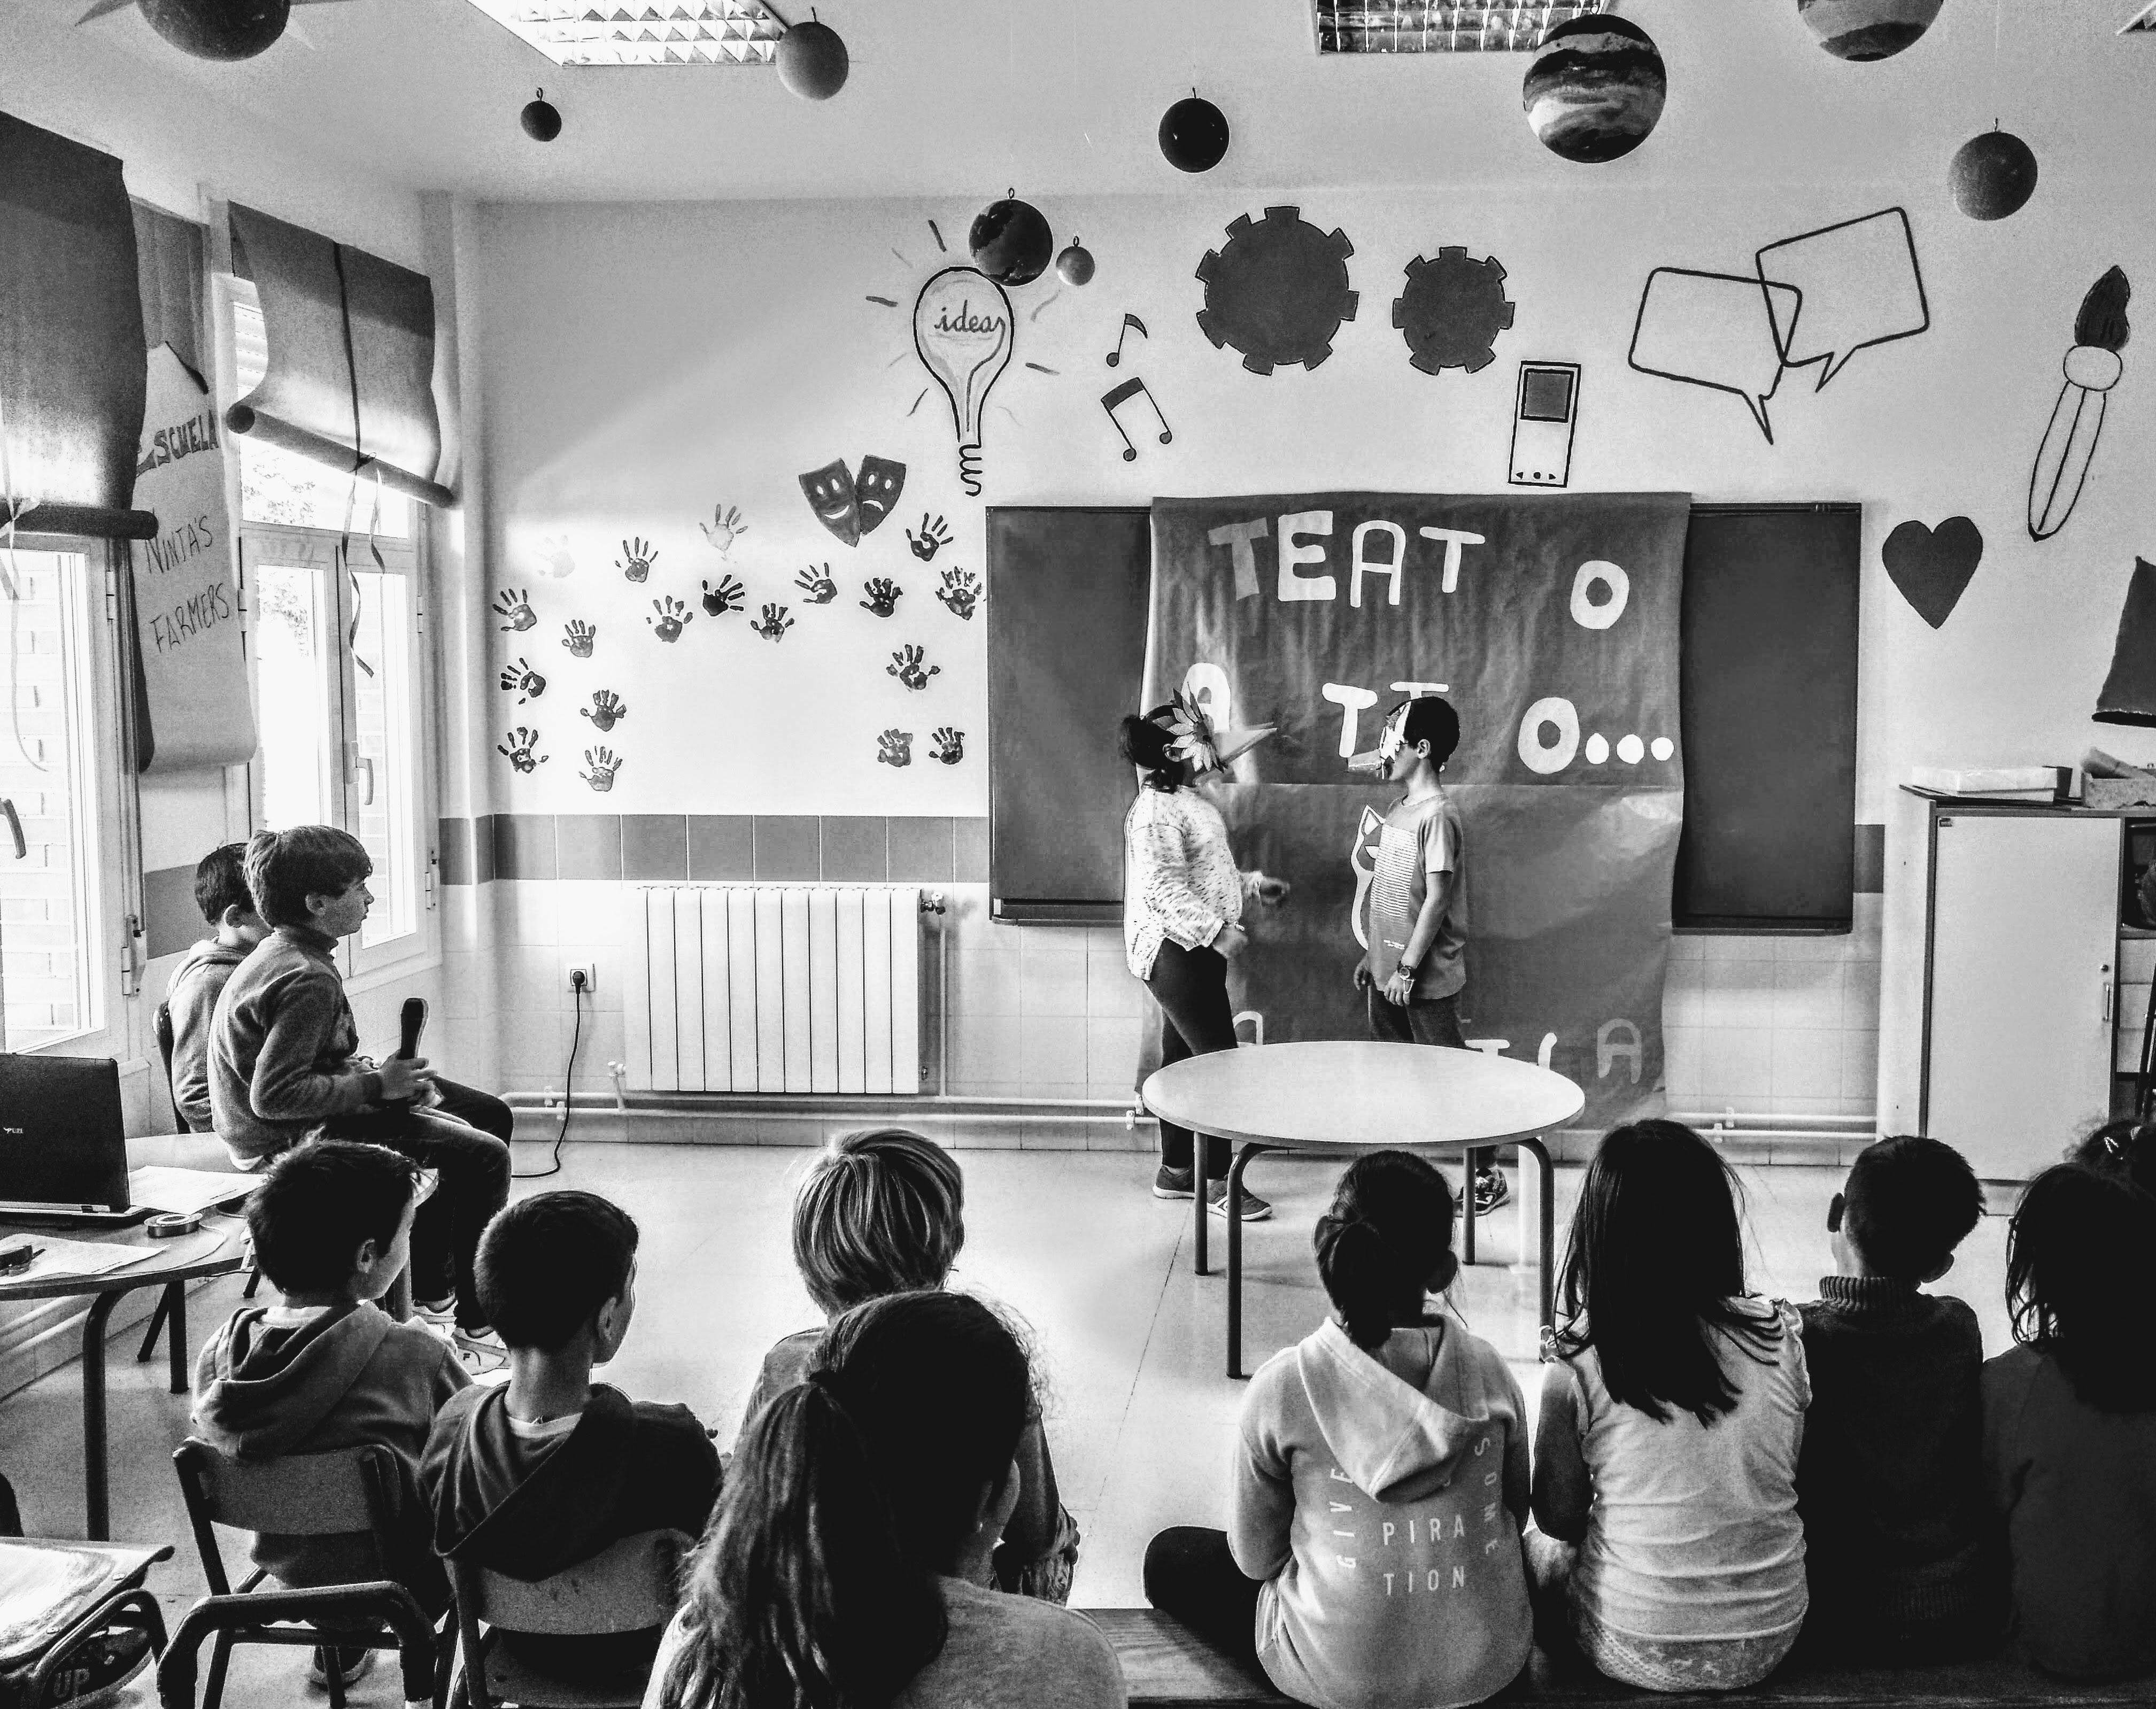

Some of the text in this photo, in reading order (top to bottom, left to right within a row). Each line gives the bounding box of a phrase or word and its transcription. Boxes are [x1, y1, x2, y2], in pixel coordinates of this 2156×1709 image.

[934, 299, 1006, 332] ideas
[150, 583, 229, 653] FARMERS
[1382, 1514, 1466, 1546] PIRA
[1383, 1565, 1466, 1596] TION
